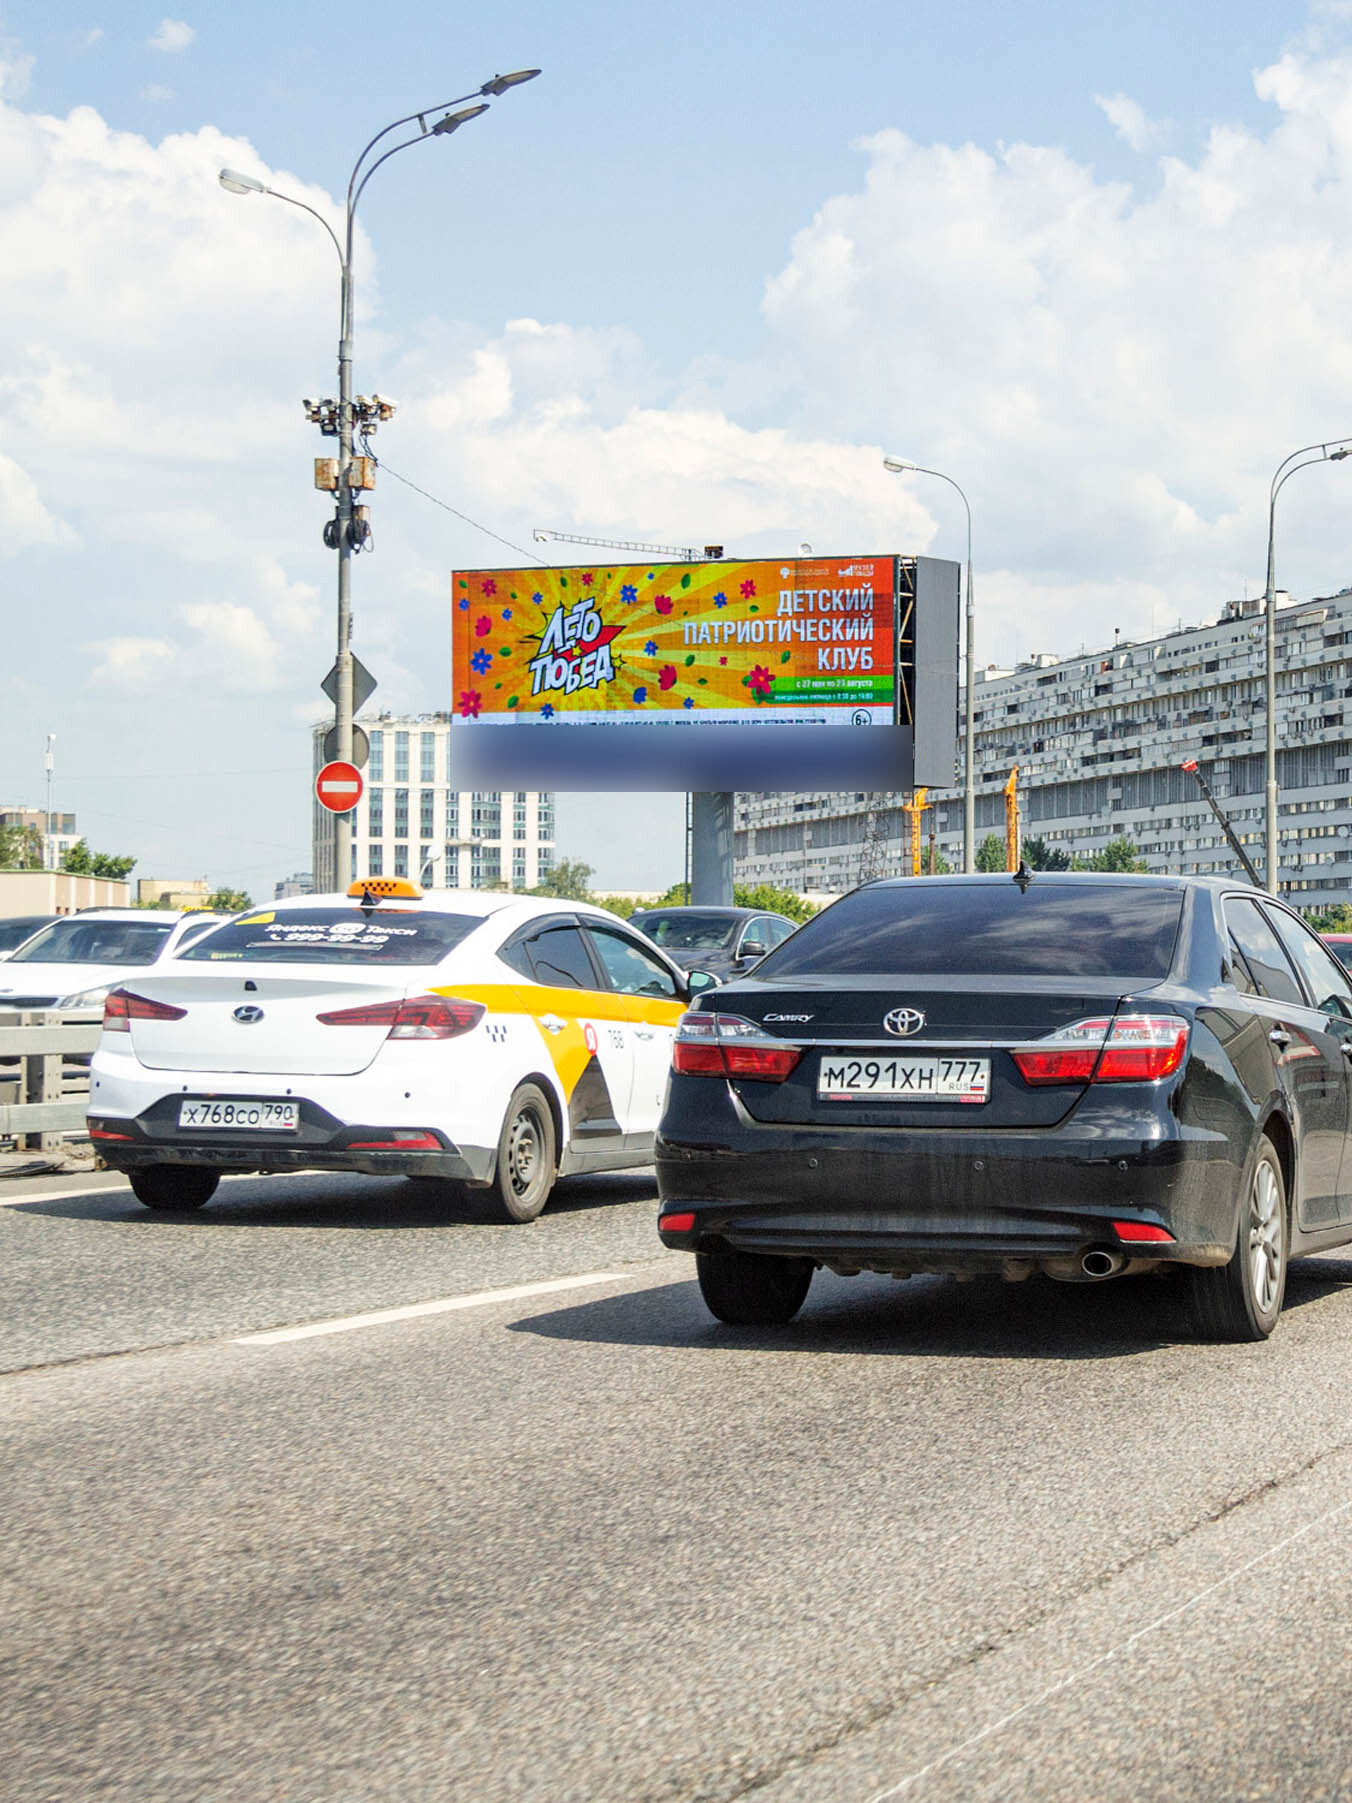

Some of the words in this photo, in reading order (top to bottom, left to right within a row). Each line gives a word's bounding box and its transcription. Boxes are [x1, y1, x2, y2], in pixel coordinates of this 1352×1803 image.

[777, 582, 874, 617] ДЕТСКИЙ
[538, 597, 602, 655] ЛЕТО
[683, 612, 874, 645] ПАТРИОТИЧЕСКИЙ
[818, 647, 874, 671] КЛУБ
[855, 713, 869, 725] 6+
[284, 932, 389, 944] 999-99-99
[365, 924, 418, 936] Такси
[827, 1061, 934, 1089] М291ХН
[940, 1060, 982, 1082] 777
[948, 1083, 969, 1091] RUS
[186, 1103, 260, 1125] Х768СО
[264, 1104, 293, 1120] 790
